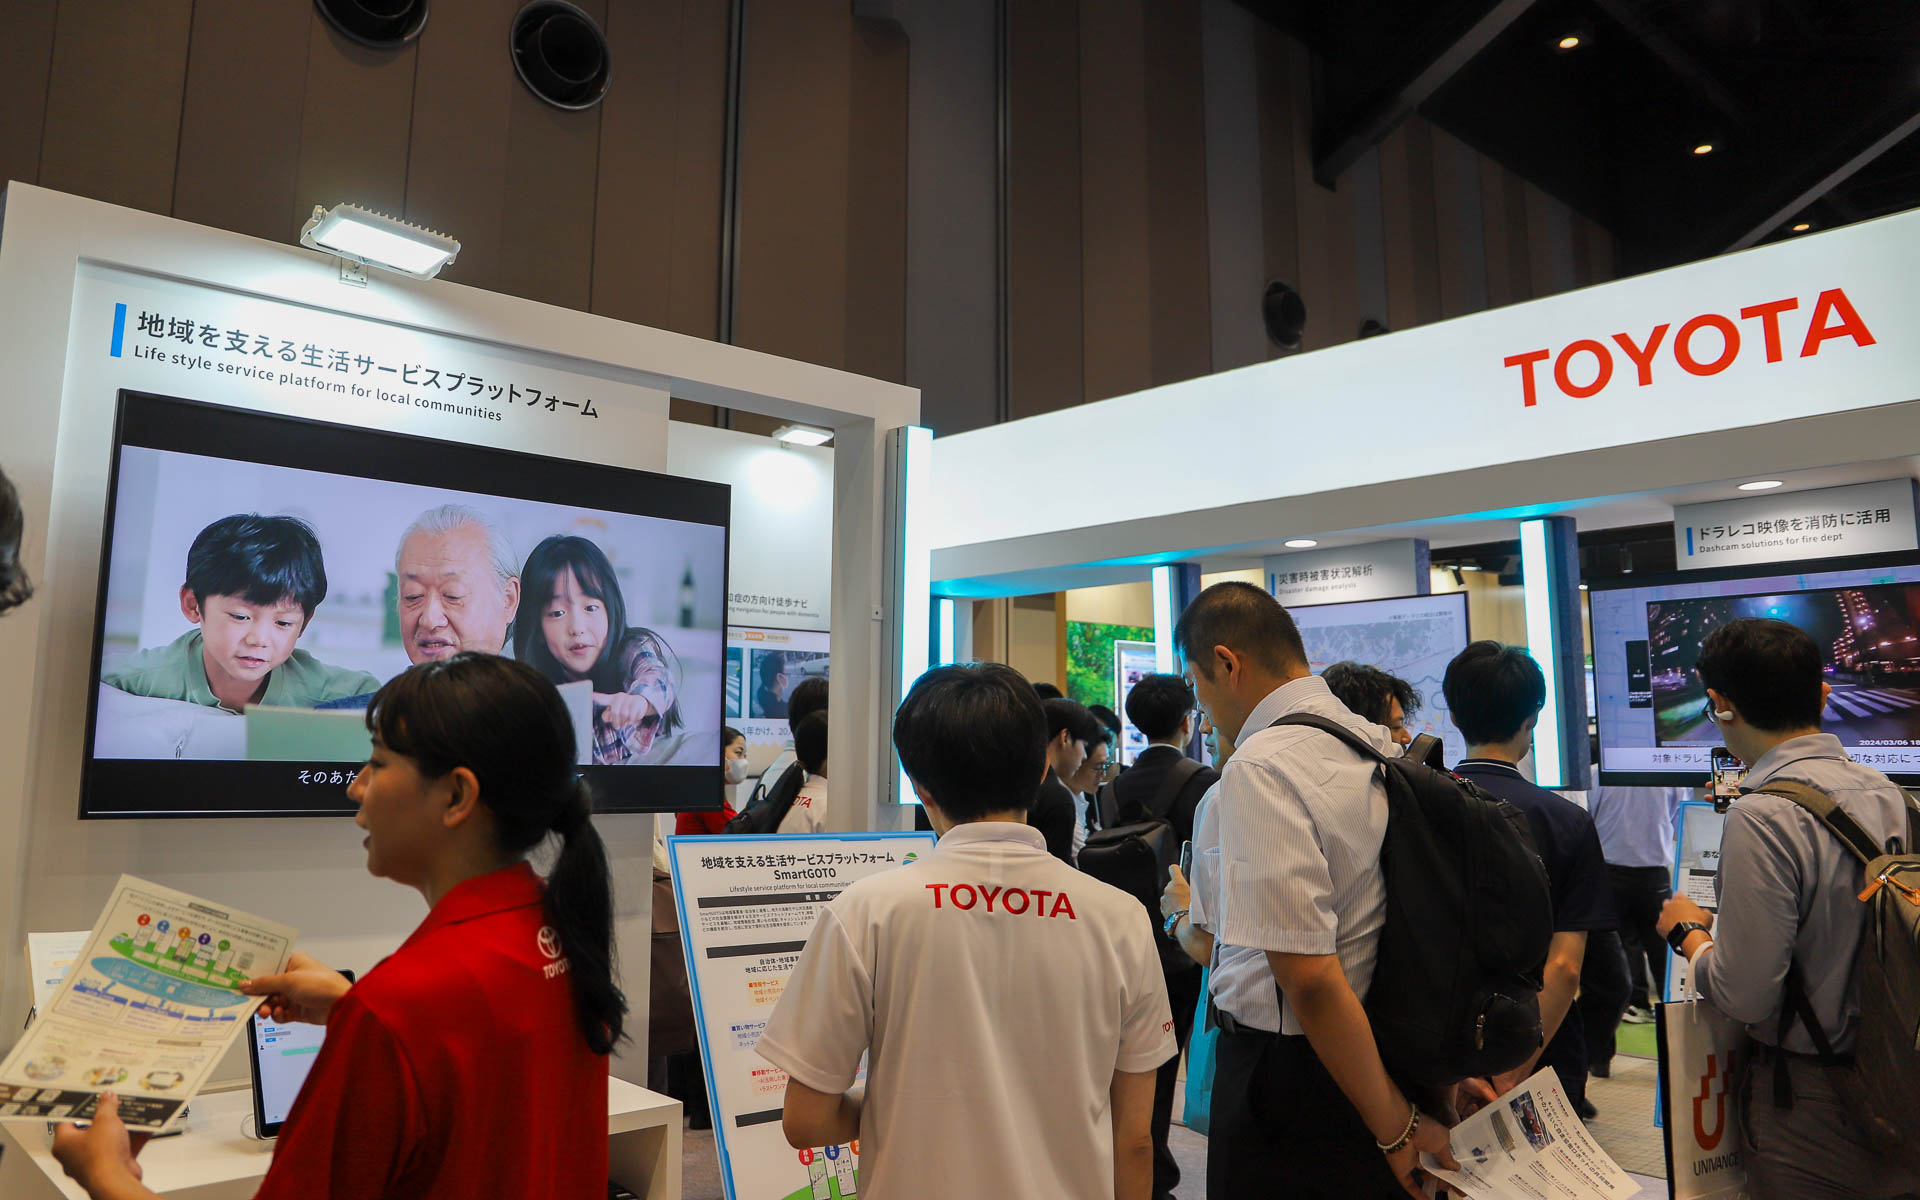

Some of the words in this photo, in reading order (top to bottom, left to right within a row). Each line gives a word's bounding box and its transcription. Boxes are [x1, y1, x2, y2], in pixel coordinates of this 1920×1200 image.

[1504, 287, 1877, 407] TOYOTA
[137, 311, 598, 419] 地域を支える生活サービスプラットフォーム
[134, 345, 166, 361] Life
[172, 352, 212, 370] style
[217, 362, 274, 381] service
[279, 373, 346, 394] platform
[351, 384, 373, 399] for
[376, 389, 411, 405] local
[415, 398, 503, 422] communities
[1700, 508, 1890, 541] ドラレコ映像を消防に活用
[1699, 543, 1740, 554] Dashcam
[1741, 538, 1783, 550] solutions
[1786, 537, 1800, 546] for
[1802, 534, 1819, 544] fire
[1820, 532, 1844, 544] dept
[1279, 564, 1373, 585] 災害時被害状況解析
[1305, 584, 1329, 593] damage
[1331, 582, 1357, 592] analysis
[298, 770, 358, 785] そのあた
[701, 852, 895, 870] 地域を支える生活サービスプラットフォーム
[774, 867, 837, 881] SmartGOTO
[730, 885, 753, 894] Lifestyle
[753, 884, 772, 892] service
[773, 883, 796, 893] platform
[796, 882, 805, 890] for
[805, 882, 819, 890] local
[925, 884, 1077, 920] TOYOTA
